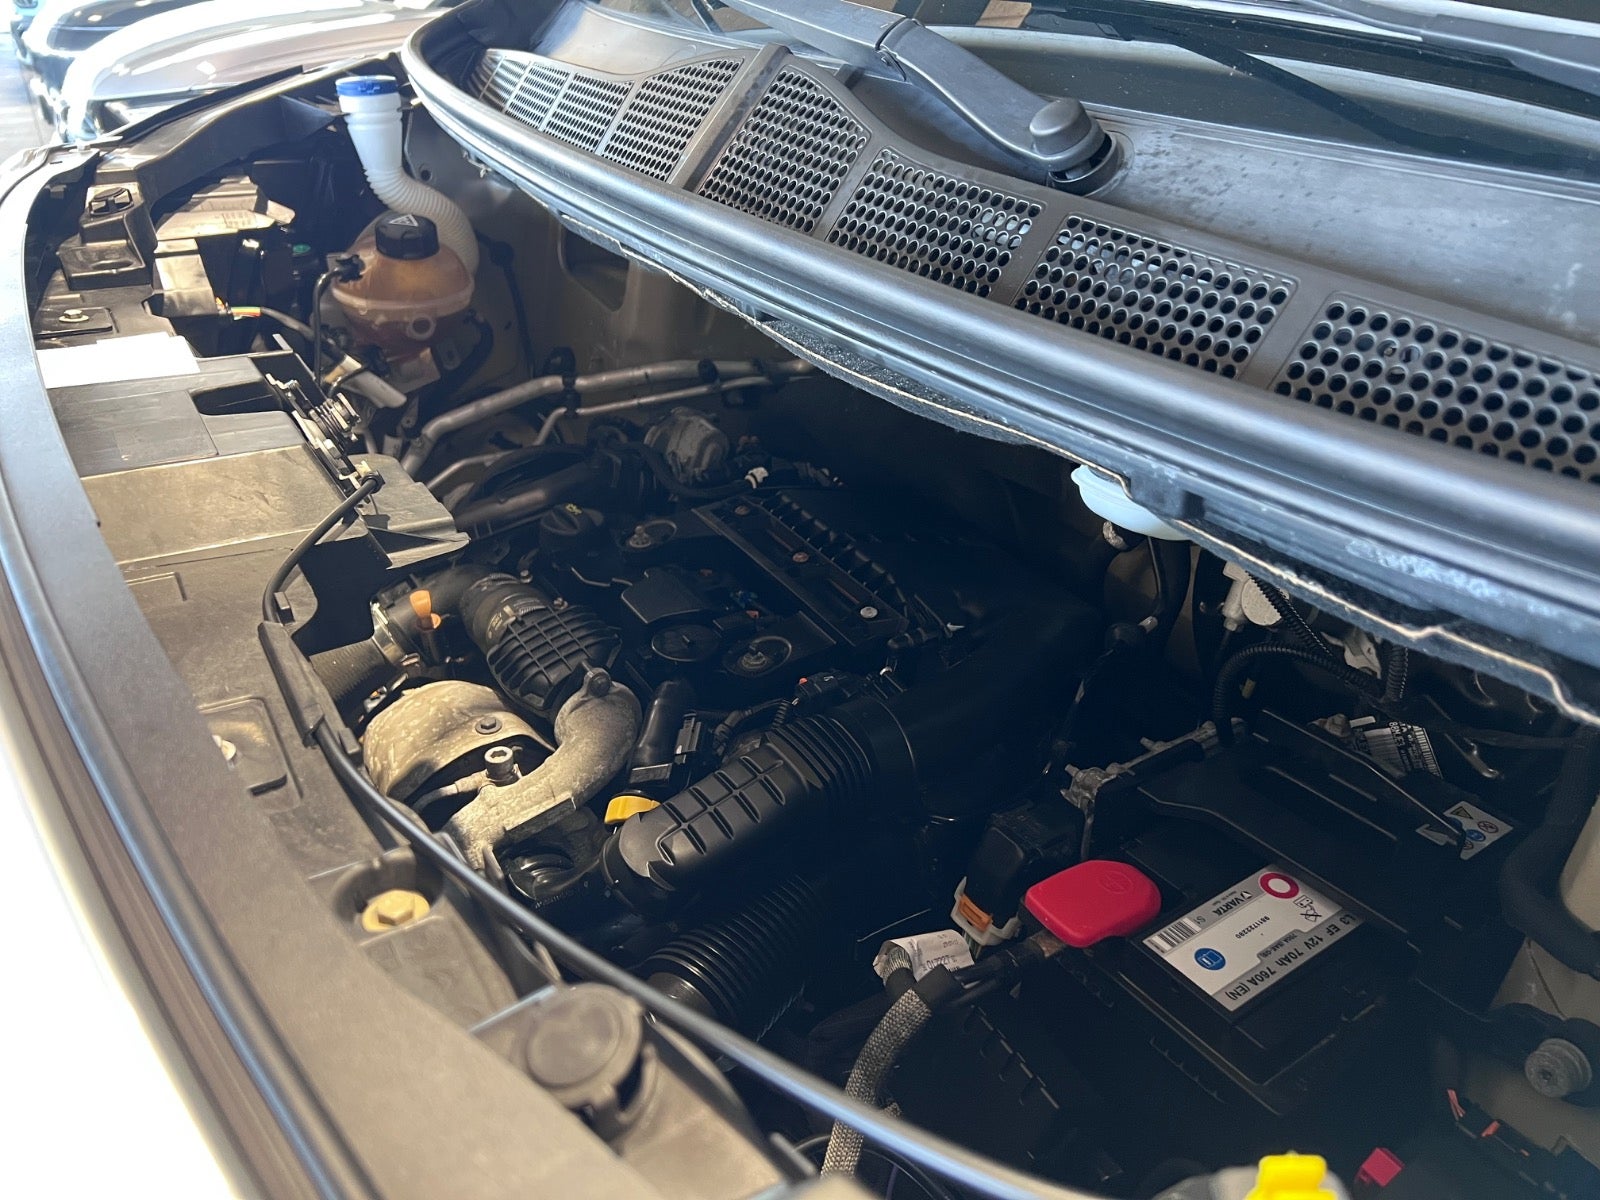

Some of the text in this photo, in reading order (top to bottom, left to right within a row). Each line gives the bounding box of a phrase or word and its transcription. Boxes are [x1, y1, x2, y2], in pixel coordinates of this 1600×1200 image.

[1212, 896, 1244, 916] VARTA
[1325, 924, 1341, 936] EF
[1303, 934, 1324, 950] 12V
[1274, 948, 1304, 967] 70Ah
[1246, 966, 1277, 986] 760A
[1224, 981, 1251, 1001] (EN)
